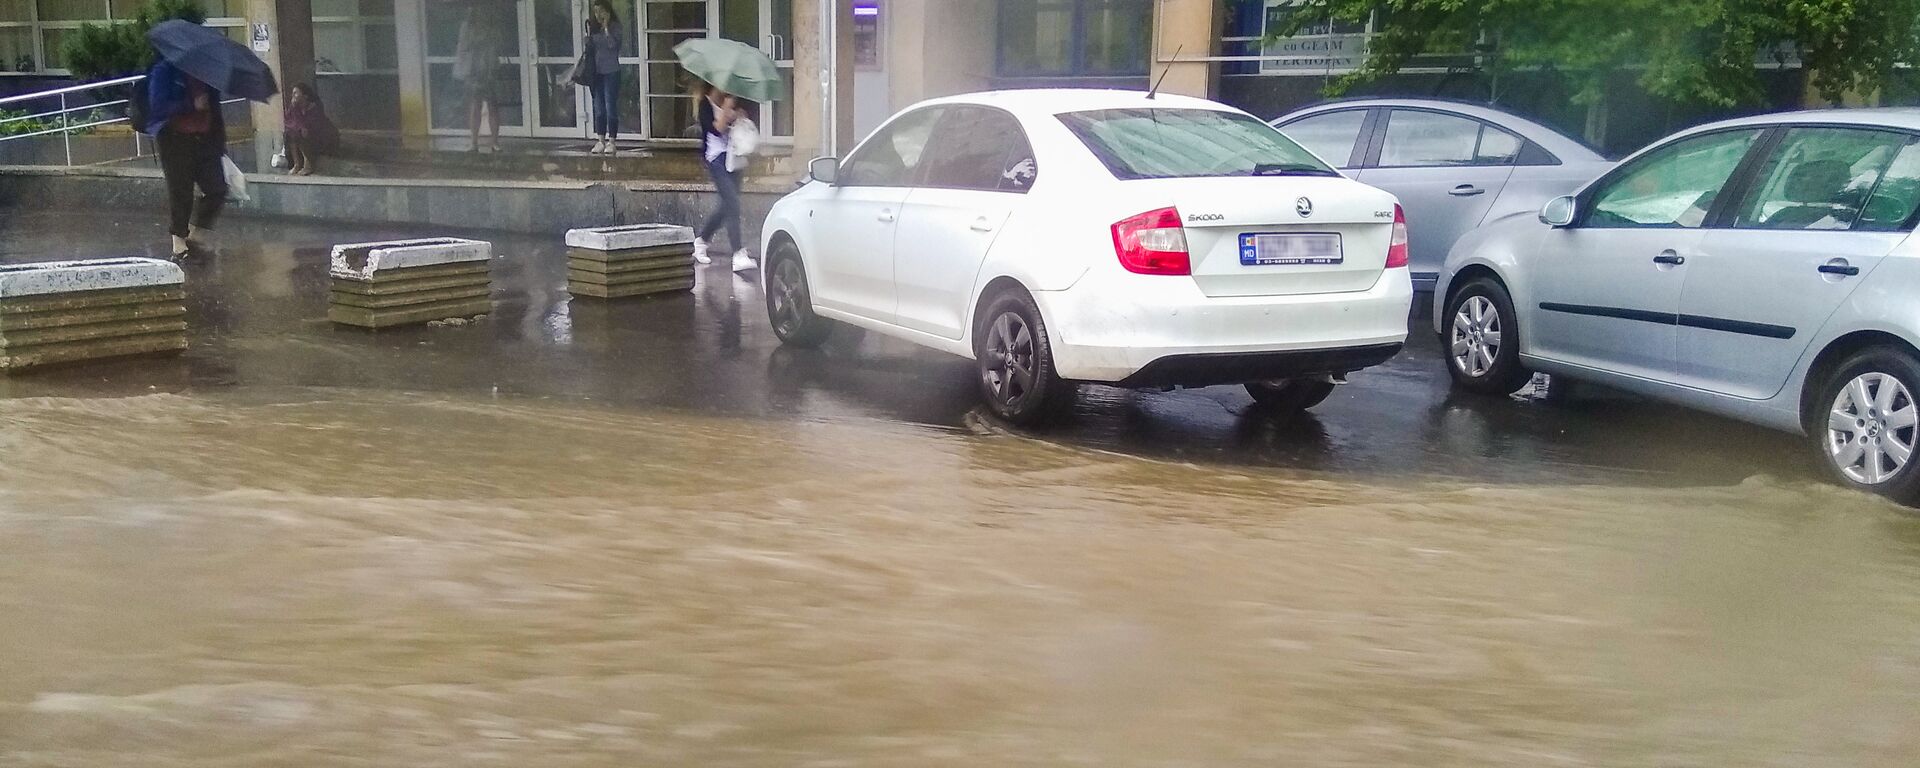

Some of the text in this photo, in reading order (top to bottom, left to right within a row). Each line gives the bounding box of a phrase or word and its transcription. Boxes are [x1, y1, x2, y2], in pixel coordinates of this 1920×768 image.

[1284, 40, 1343, 51] cu GEAM
[1244, 249, 1255, 258] MD
